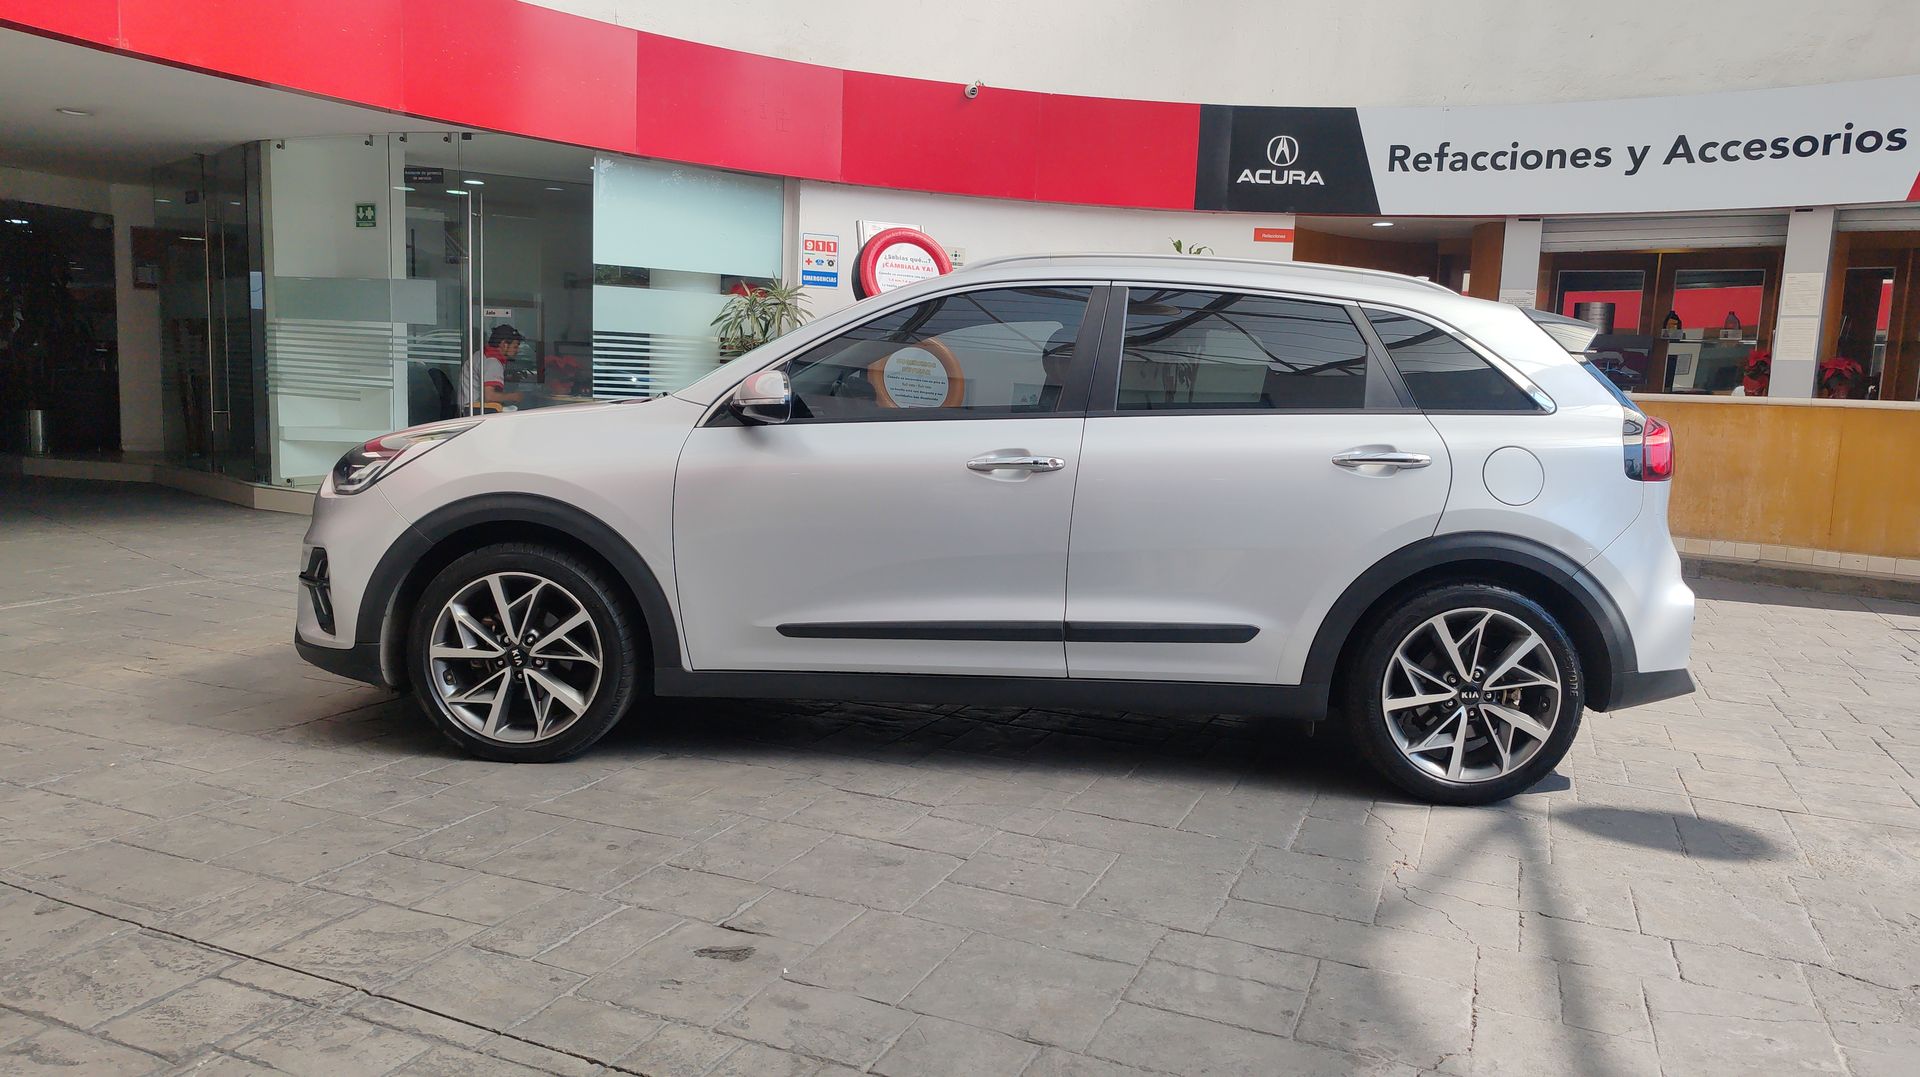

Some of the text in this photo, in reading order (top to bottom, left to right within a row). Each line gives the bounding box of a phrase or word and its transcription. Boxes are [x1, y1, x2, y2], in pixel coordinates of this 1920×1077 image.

[1388, 122, 1908, 176] Refacciones y Accesorios
[1236, 169, 1325, 186] ACURA
[805, 240, 836, 252] 911
[803, 275, 837, 283] EMERGENCIAS
[511, 649, 523, 666] KIA
[1461, 691, 1479, 699] KIA
